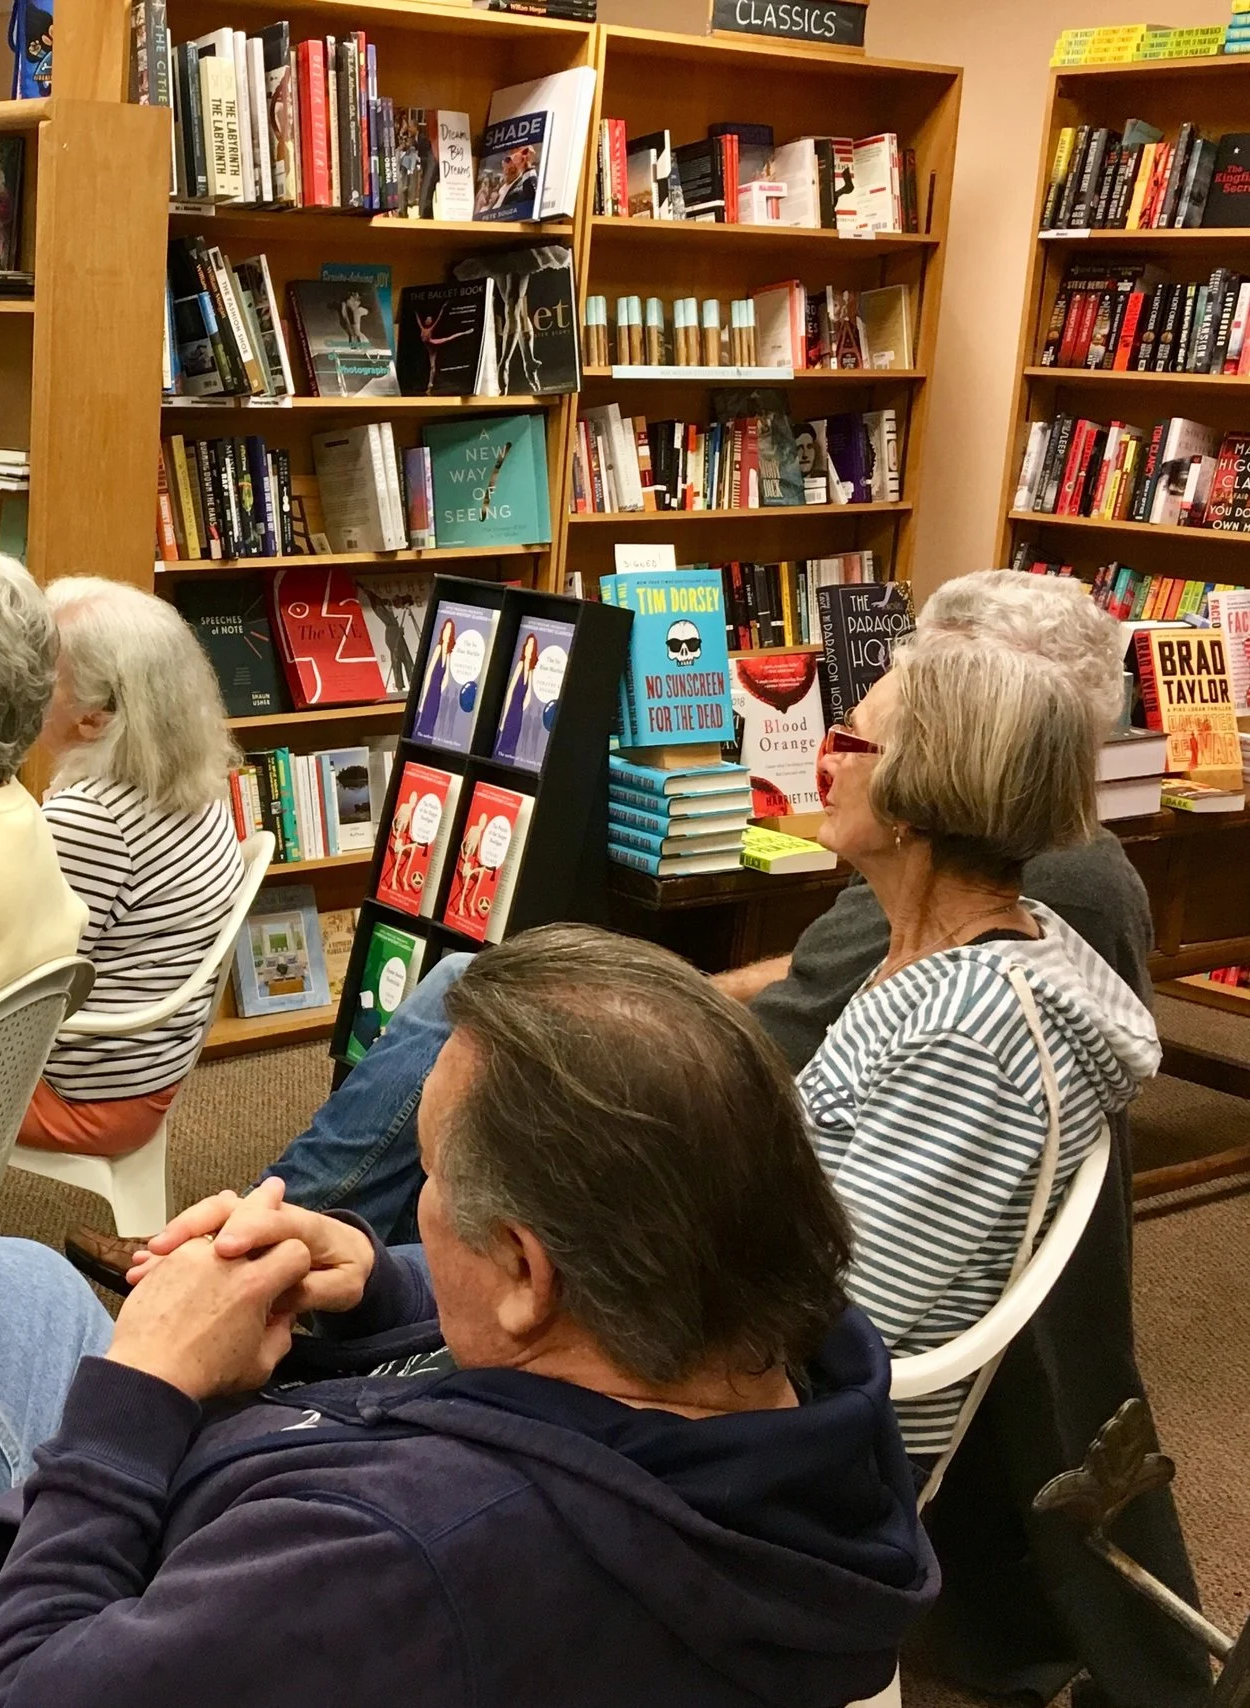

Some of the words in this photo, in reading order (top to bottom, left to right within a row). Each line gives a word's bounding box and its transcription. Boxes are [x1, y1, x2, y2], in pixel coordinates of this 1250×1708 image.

[735, 0, 837, 37] CLASSICS
[154, 23, 165, 54] THE
[156, 60, 168, 107] CITIE
[212, 98, 223, 117] THE
[226, 100, 236, 118] THE
[440, 123, 470, 142] Dream
[485, 117, 543, 147] SHADE
[213, 119, 227, 175] LABYRINTH
[227, 120, 240, 176] LABYRINTH
[448, 144, 464, 161] Big
[1085, 141, 1097, 173] WASHINGTON
[442, 161, 471, 178] Dreams
[1214, 172, 1250, 184] Kingfi
[1227, 164, 1243, 174] The
[1222, 183, 1250, 194] Secr
[374, 271, 390, 287] JOY
[1067, 280, 1088, 290] STEVE
[411, 292, 425, 301] THE
[427, 289, 458, 300] BALLET
[460, 285, 484, 297] BOOK
[222, 281, 231, 294] THE
[227, 296, 241, 332] FASHION
[237, 331, 249, 355] SHOE
[1147, 311, 1157, 330] ORDER
[1166, 311, 1176, 330] ORDER
[1196, 314, 1213, 358] MANSION
[339, 365, 391, 377] Photography
[479, 428, 490, 440] A
[1152, 424, 1164, 443] TOM
[369, 430, 385, 492] AUTHOR
[382, 428, 398, 491] AUTHOR
[465, 445, 507, 462] NEW
[1144, 443, 1161, 478] CLANCY
[204, 473, 213, 493] DOWN
[449, 467, 487, 484] WAY
[472, 486, 497, 501] OF
[444, 504, 512, 524] SEEING
[1209, 503, 1233, 517] YOU
[1213, 519, 1239, 531] OWN
[636, 587, 667, 616] TIM
[670, 586, 720, 614] DORSEY
[850, 595, 870, 612] THE
[200, 615, 243, 625] SPEECHES
[848, 614, 912, 633] PARAGON
[211, 627, 219, 636] of
[220, 625, 244, 635] NOTE
[298, 624, 325, 642] The
[327, 622, 363, 640] EYE
[823, 623, 838, 682] PARAGON
[1135, 635, 1152, 666] BRAD
[1157, 639, 1226, 677] BRAD
[645, 675, 663, 700] NO
[665, 672, 725, 699] SUNSCREEN
[1162, 678, 1231, 705] TAYLOR
[252, 692, 271, 700] SHAUN
[830, 687, 843, 722] HOTEL
[648, 705, 673, 733] FOR
[674, 703, 695, 731] THE
[696, 703, 723, 729] DEAD
[764, 716, 808, 734] Blood
[1167, 713, 1235, 733] DAUGHTER
[759, 736, 816, 754] Orange
[1198, 732, 1240, 766] WAR
[765, 793, 801, 807] HARRIET
[803, 791, 825, 804] TYCE
[1164, 796, 1188, 809] DARK
